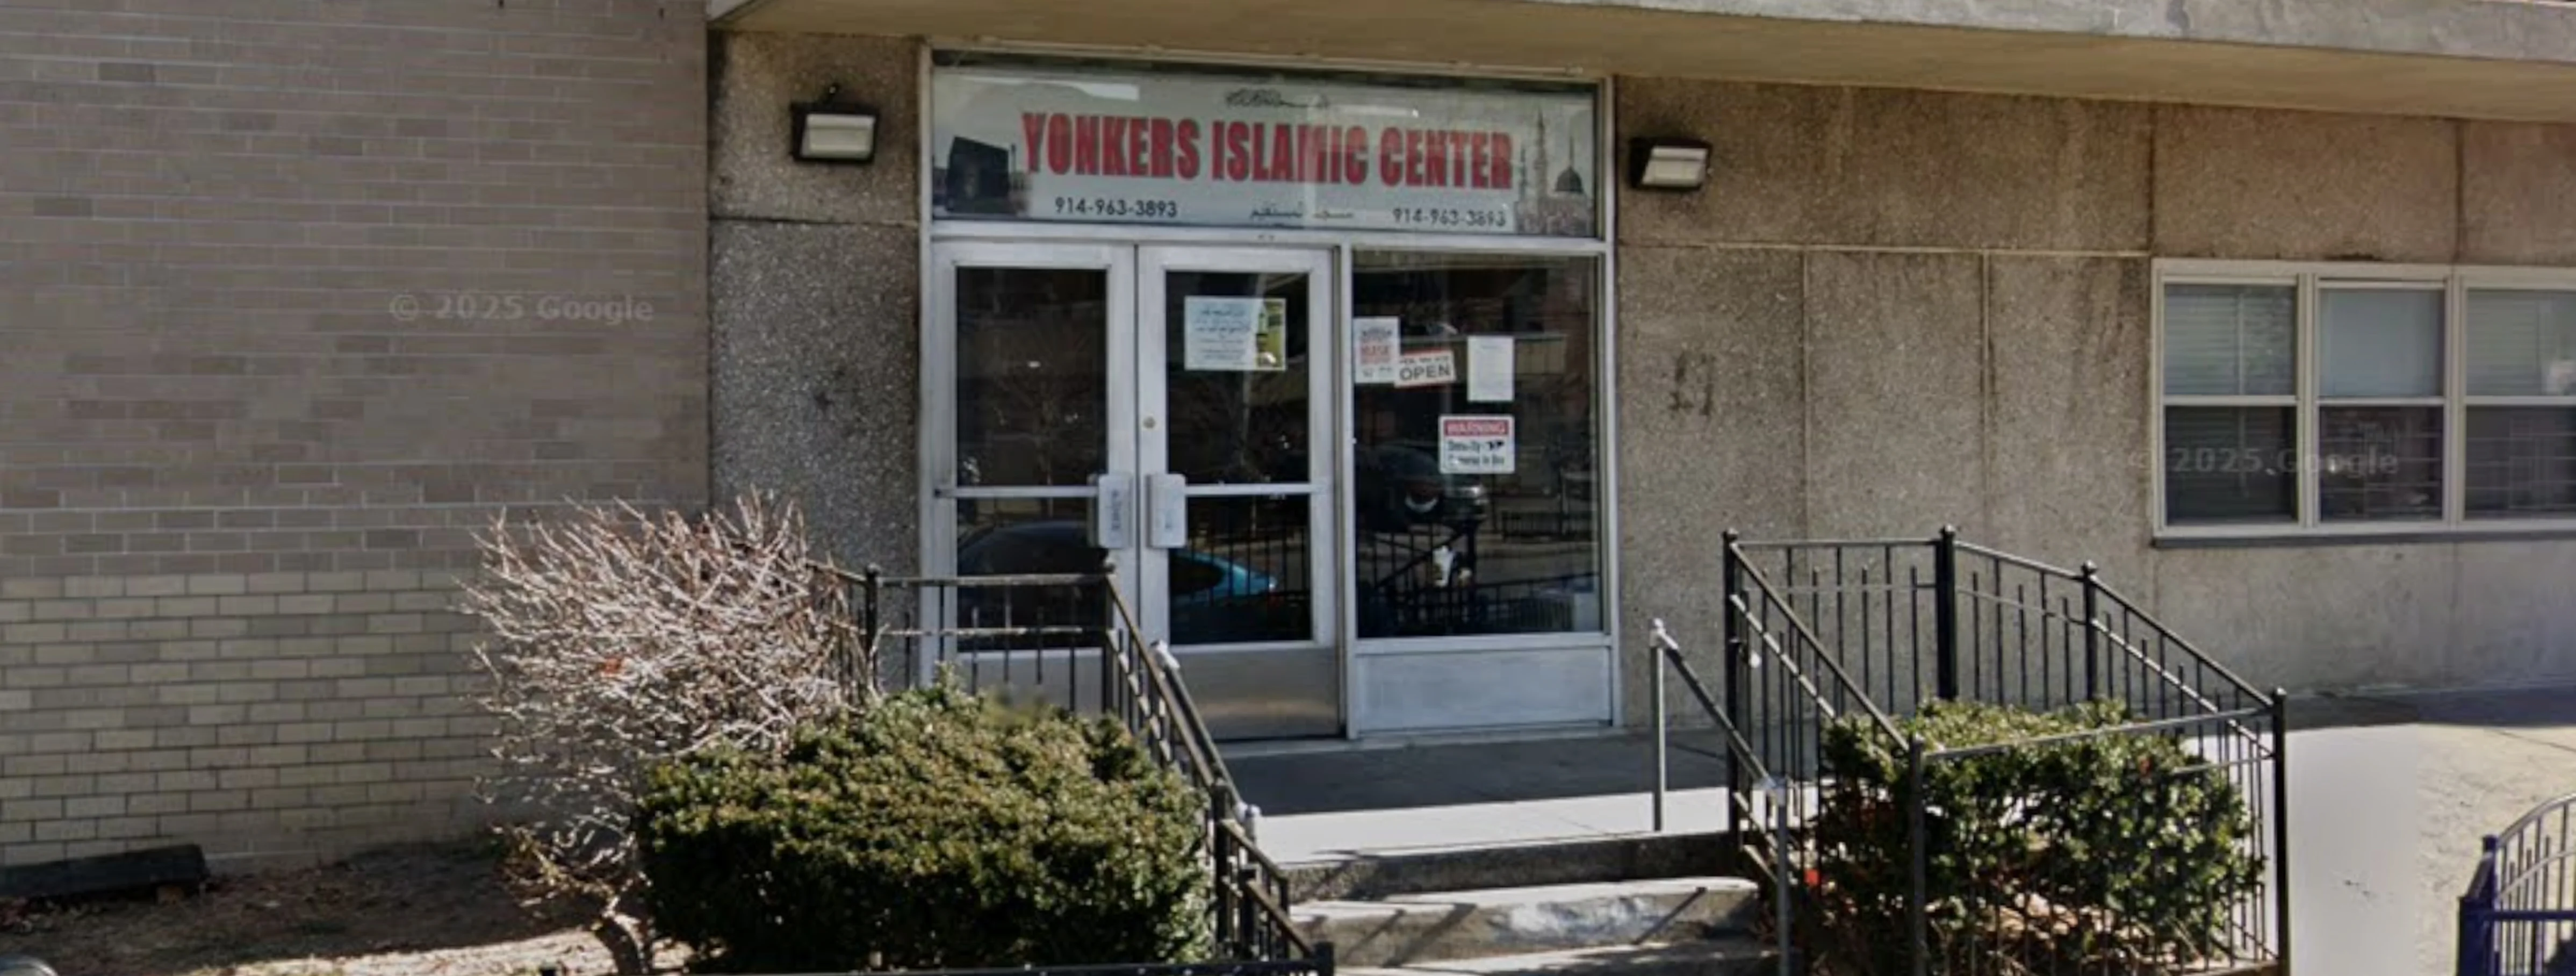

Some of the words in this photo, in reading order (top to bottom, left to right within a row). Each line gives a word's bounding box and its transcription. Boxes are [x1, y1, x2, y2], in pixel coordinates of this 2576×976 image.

[1021, 112, 1201, 180] YONKERS
[1212, 119, 1368, 185] ISLAMIC
[1380, 126, 1513, 189] CENTER
[1055, 197, 1178, 218] 914-963-3893
[1399, 363, 1451, 381] OPEN
